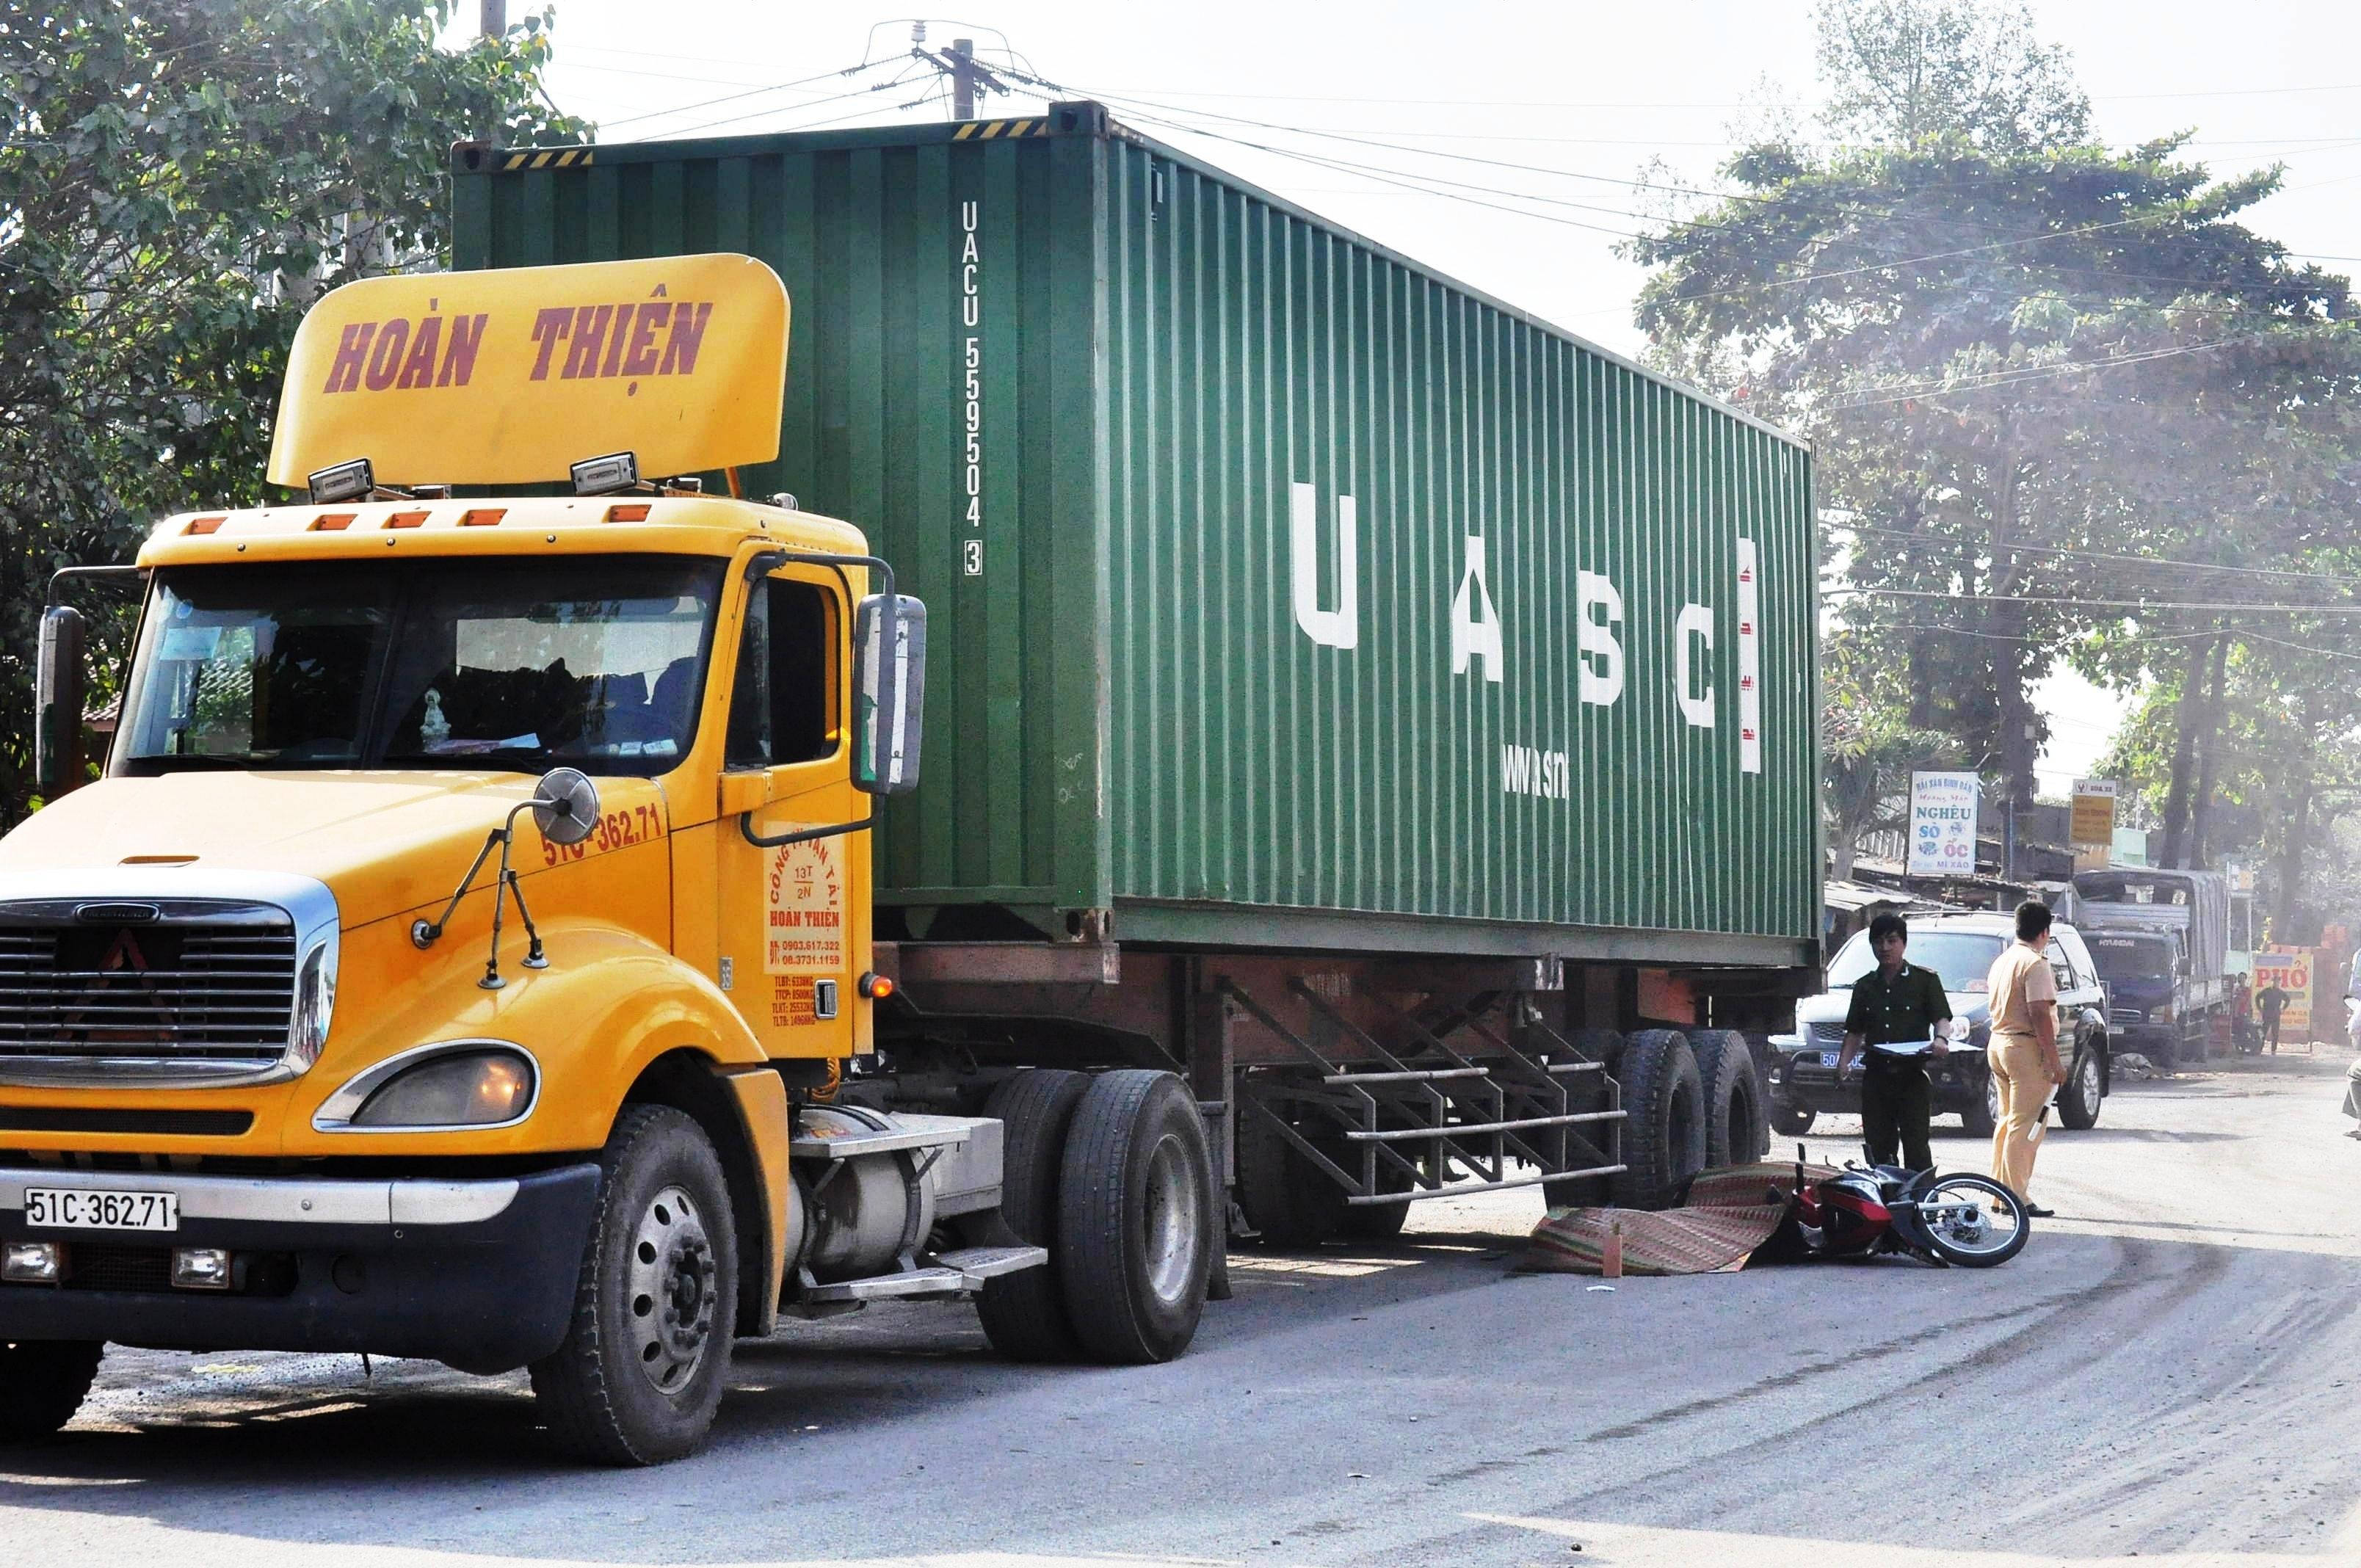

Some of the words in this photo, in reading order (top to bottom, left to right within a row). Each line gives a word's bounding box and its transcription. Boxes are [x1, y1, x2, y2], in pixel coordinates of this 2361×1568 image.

[962, 201, 979, 326] UACU
[529, 283, 714, 396] THIỆN
[965, 338, 981, 526] 559504
[967, 542, 981, 574] 3
[1916, 805, 1971, 820] NGHÊU
[1919, 822, 1940, 838] SÒ
[1943, 838, 1968, 857] ỐC
[769, 846, 790, 904] CÔNG
[826, 865, 840, 905] TẢI
[805, 907, 839, 932] THIỆN
[783, 940, 840, 951] 0903.617.322
[2099, 939, 2135, 947] HYUNDAI
[783, 956, 840, 965] 08.3731.1159
